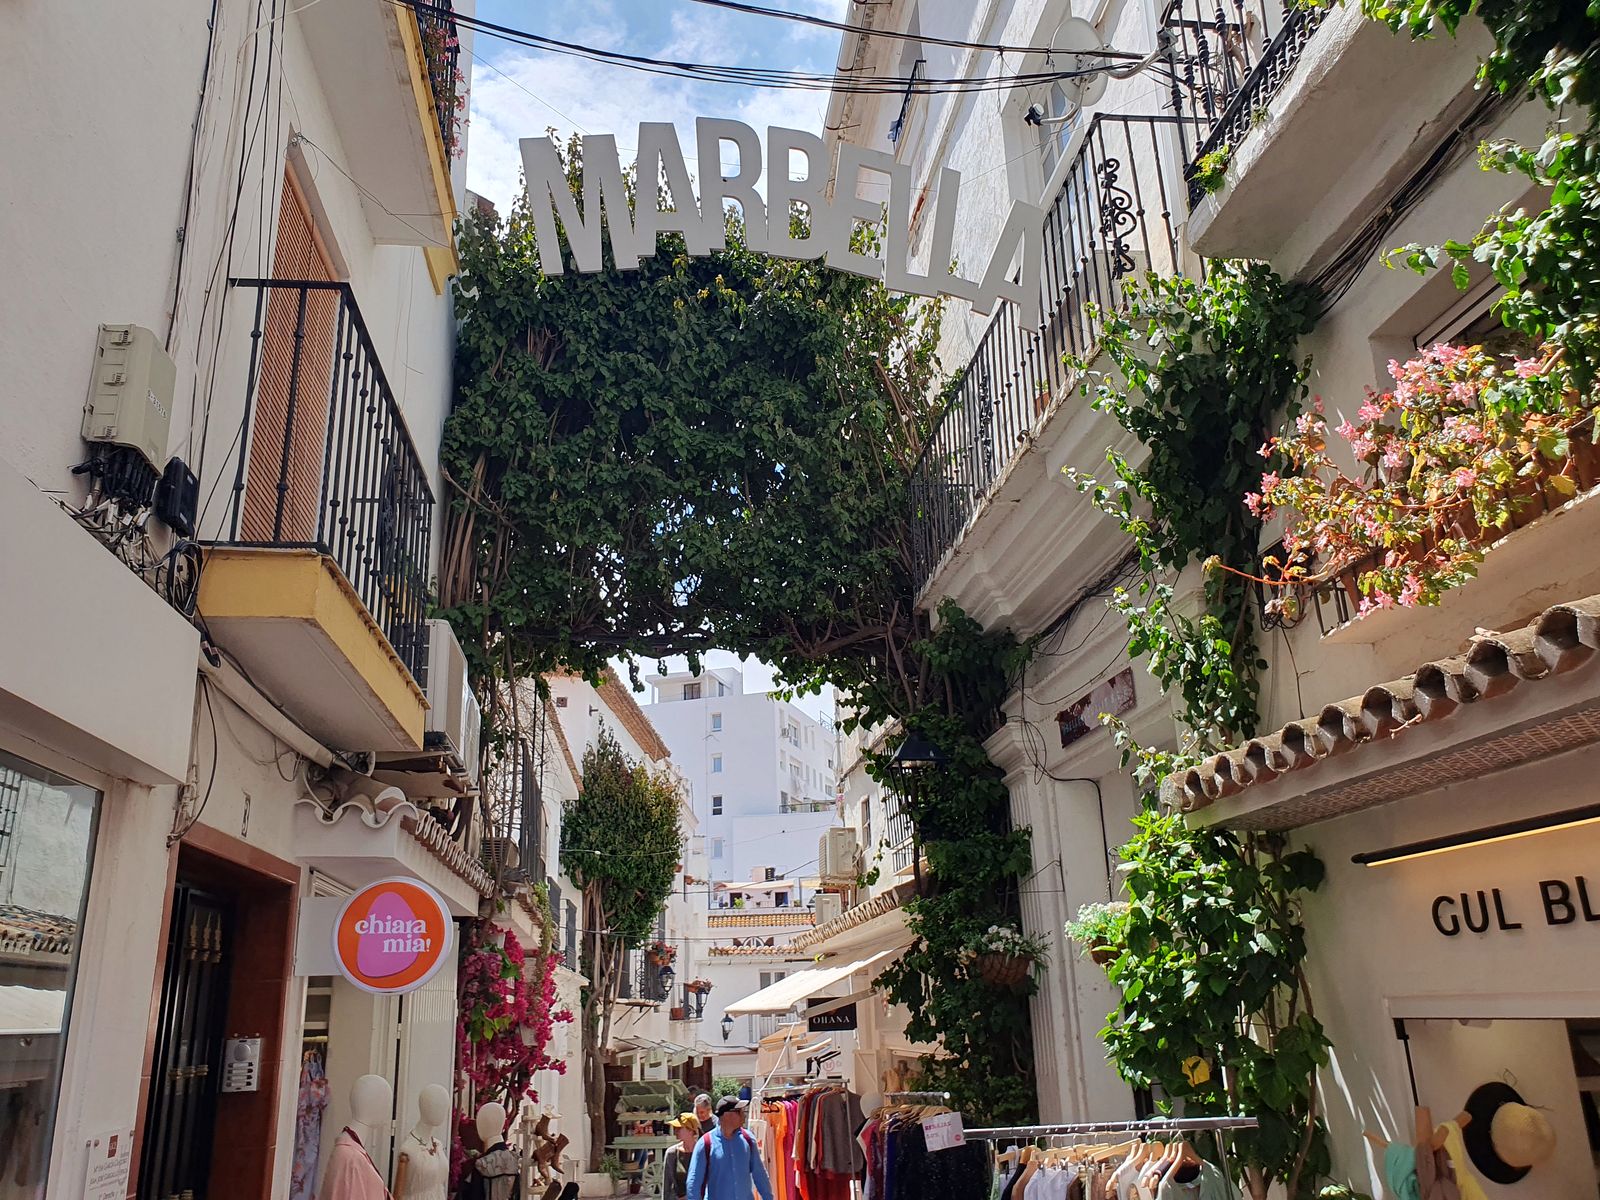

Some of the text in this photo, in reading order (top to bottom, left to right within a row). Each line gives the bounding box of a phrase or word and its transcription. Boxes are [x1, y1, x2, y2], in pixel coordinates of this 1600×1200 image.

[518, 117, 1046, 335] MARBELLA
[1431, 875, 1600, 937] GUL BL
[354, 913, 427, 935] chiara
[382, 934, 431, 953] mia!
[812, 1015, 850, 1024] OHANA
